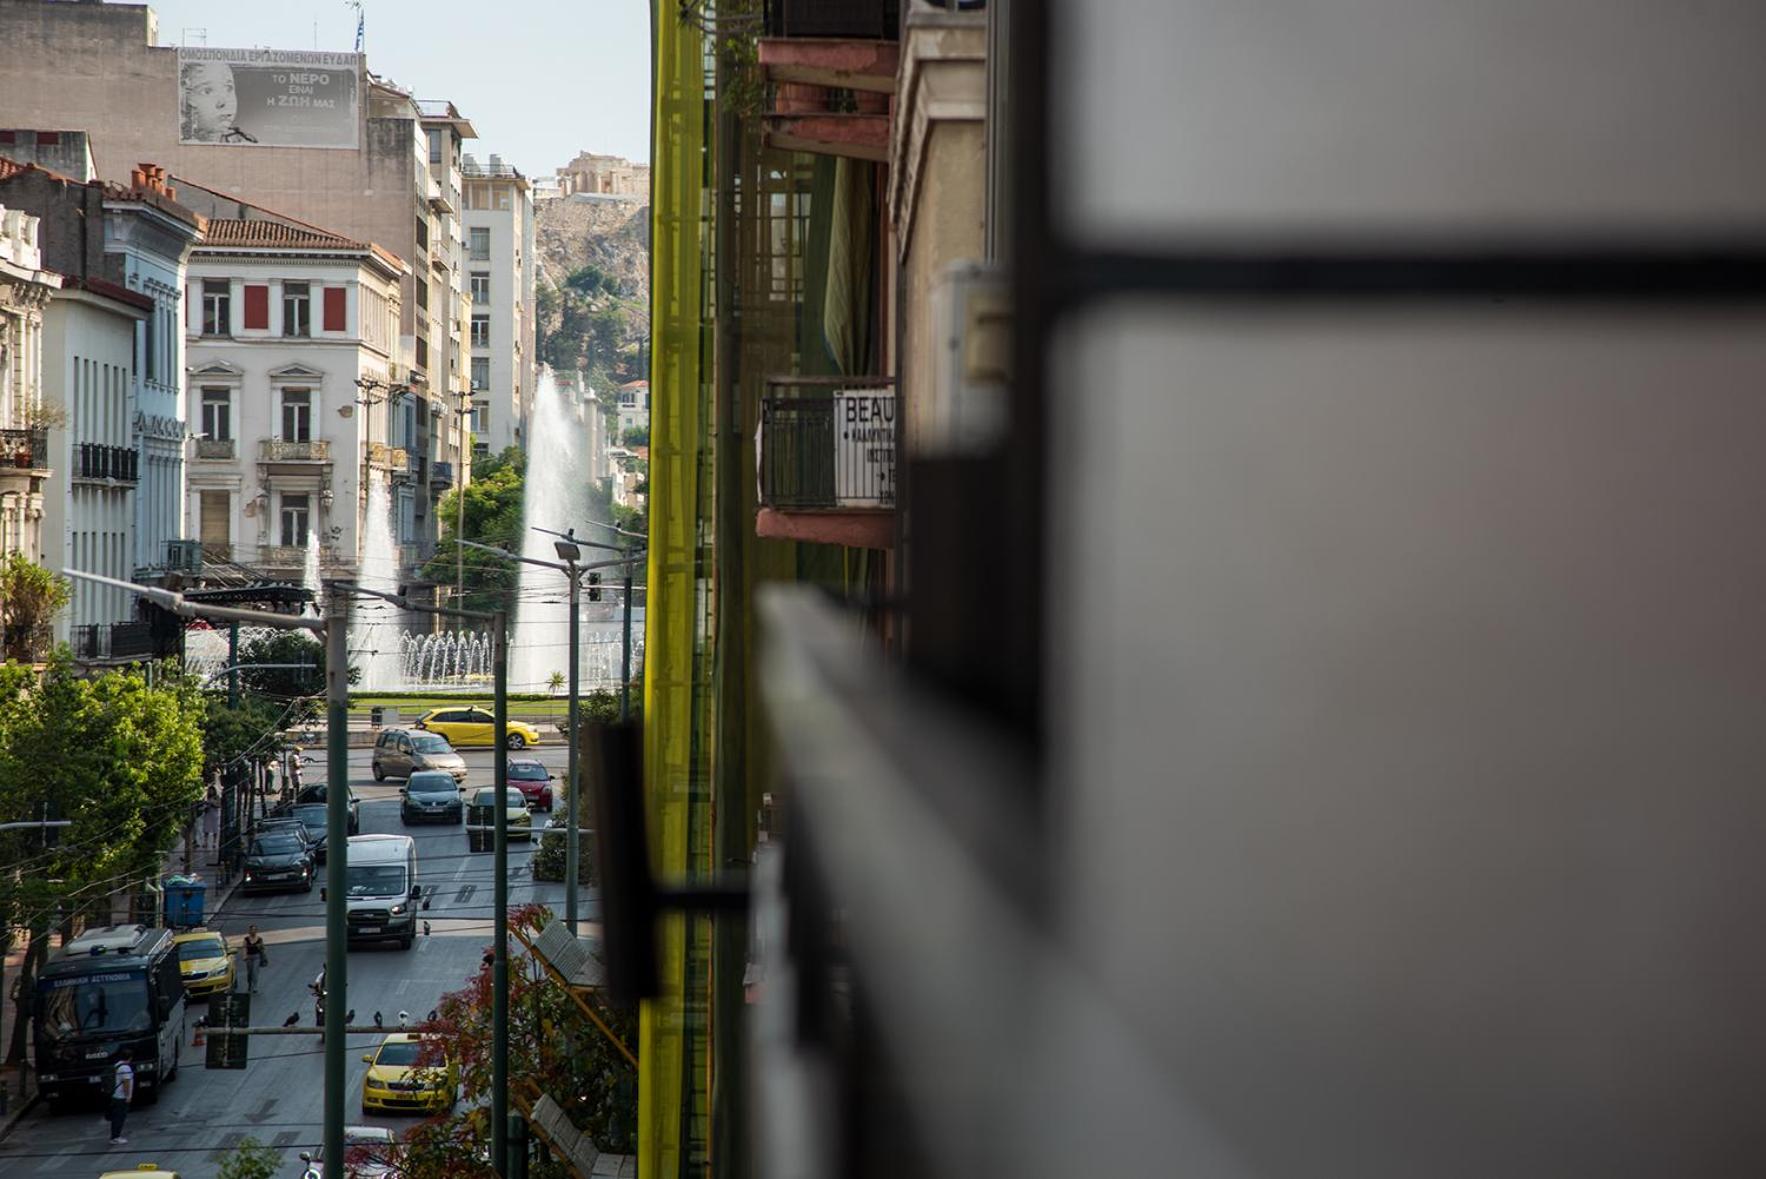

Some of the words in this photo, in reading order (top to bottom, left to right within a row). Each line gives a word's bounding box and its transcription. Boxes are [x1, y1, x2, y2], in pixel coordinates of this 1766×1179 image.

[180, 48, 247, 61] ΟΜΟΣΠΟΝΔΙΑ
[249, 50, 321, 64] ΕΡΓΑΖΟΜΕΝΩΝ
[323, 53, 357, 66] ΕΥΔΑΠ
[272, 74, 287, 84] ΤΟ
[290, 73, 330, 85] ΝΕΡΟ
[289, 85, 314, 94] ΕΙΝΑΙ
[267, 97, 275, 106] Η
[278, 96, 311, 107] ΖΩΗ
[313, 99, 336, 109] ΜΑΣ
[846, 396, 895, 422] BEAU
